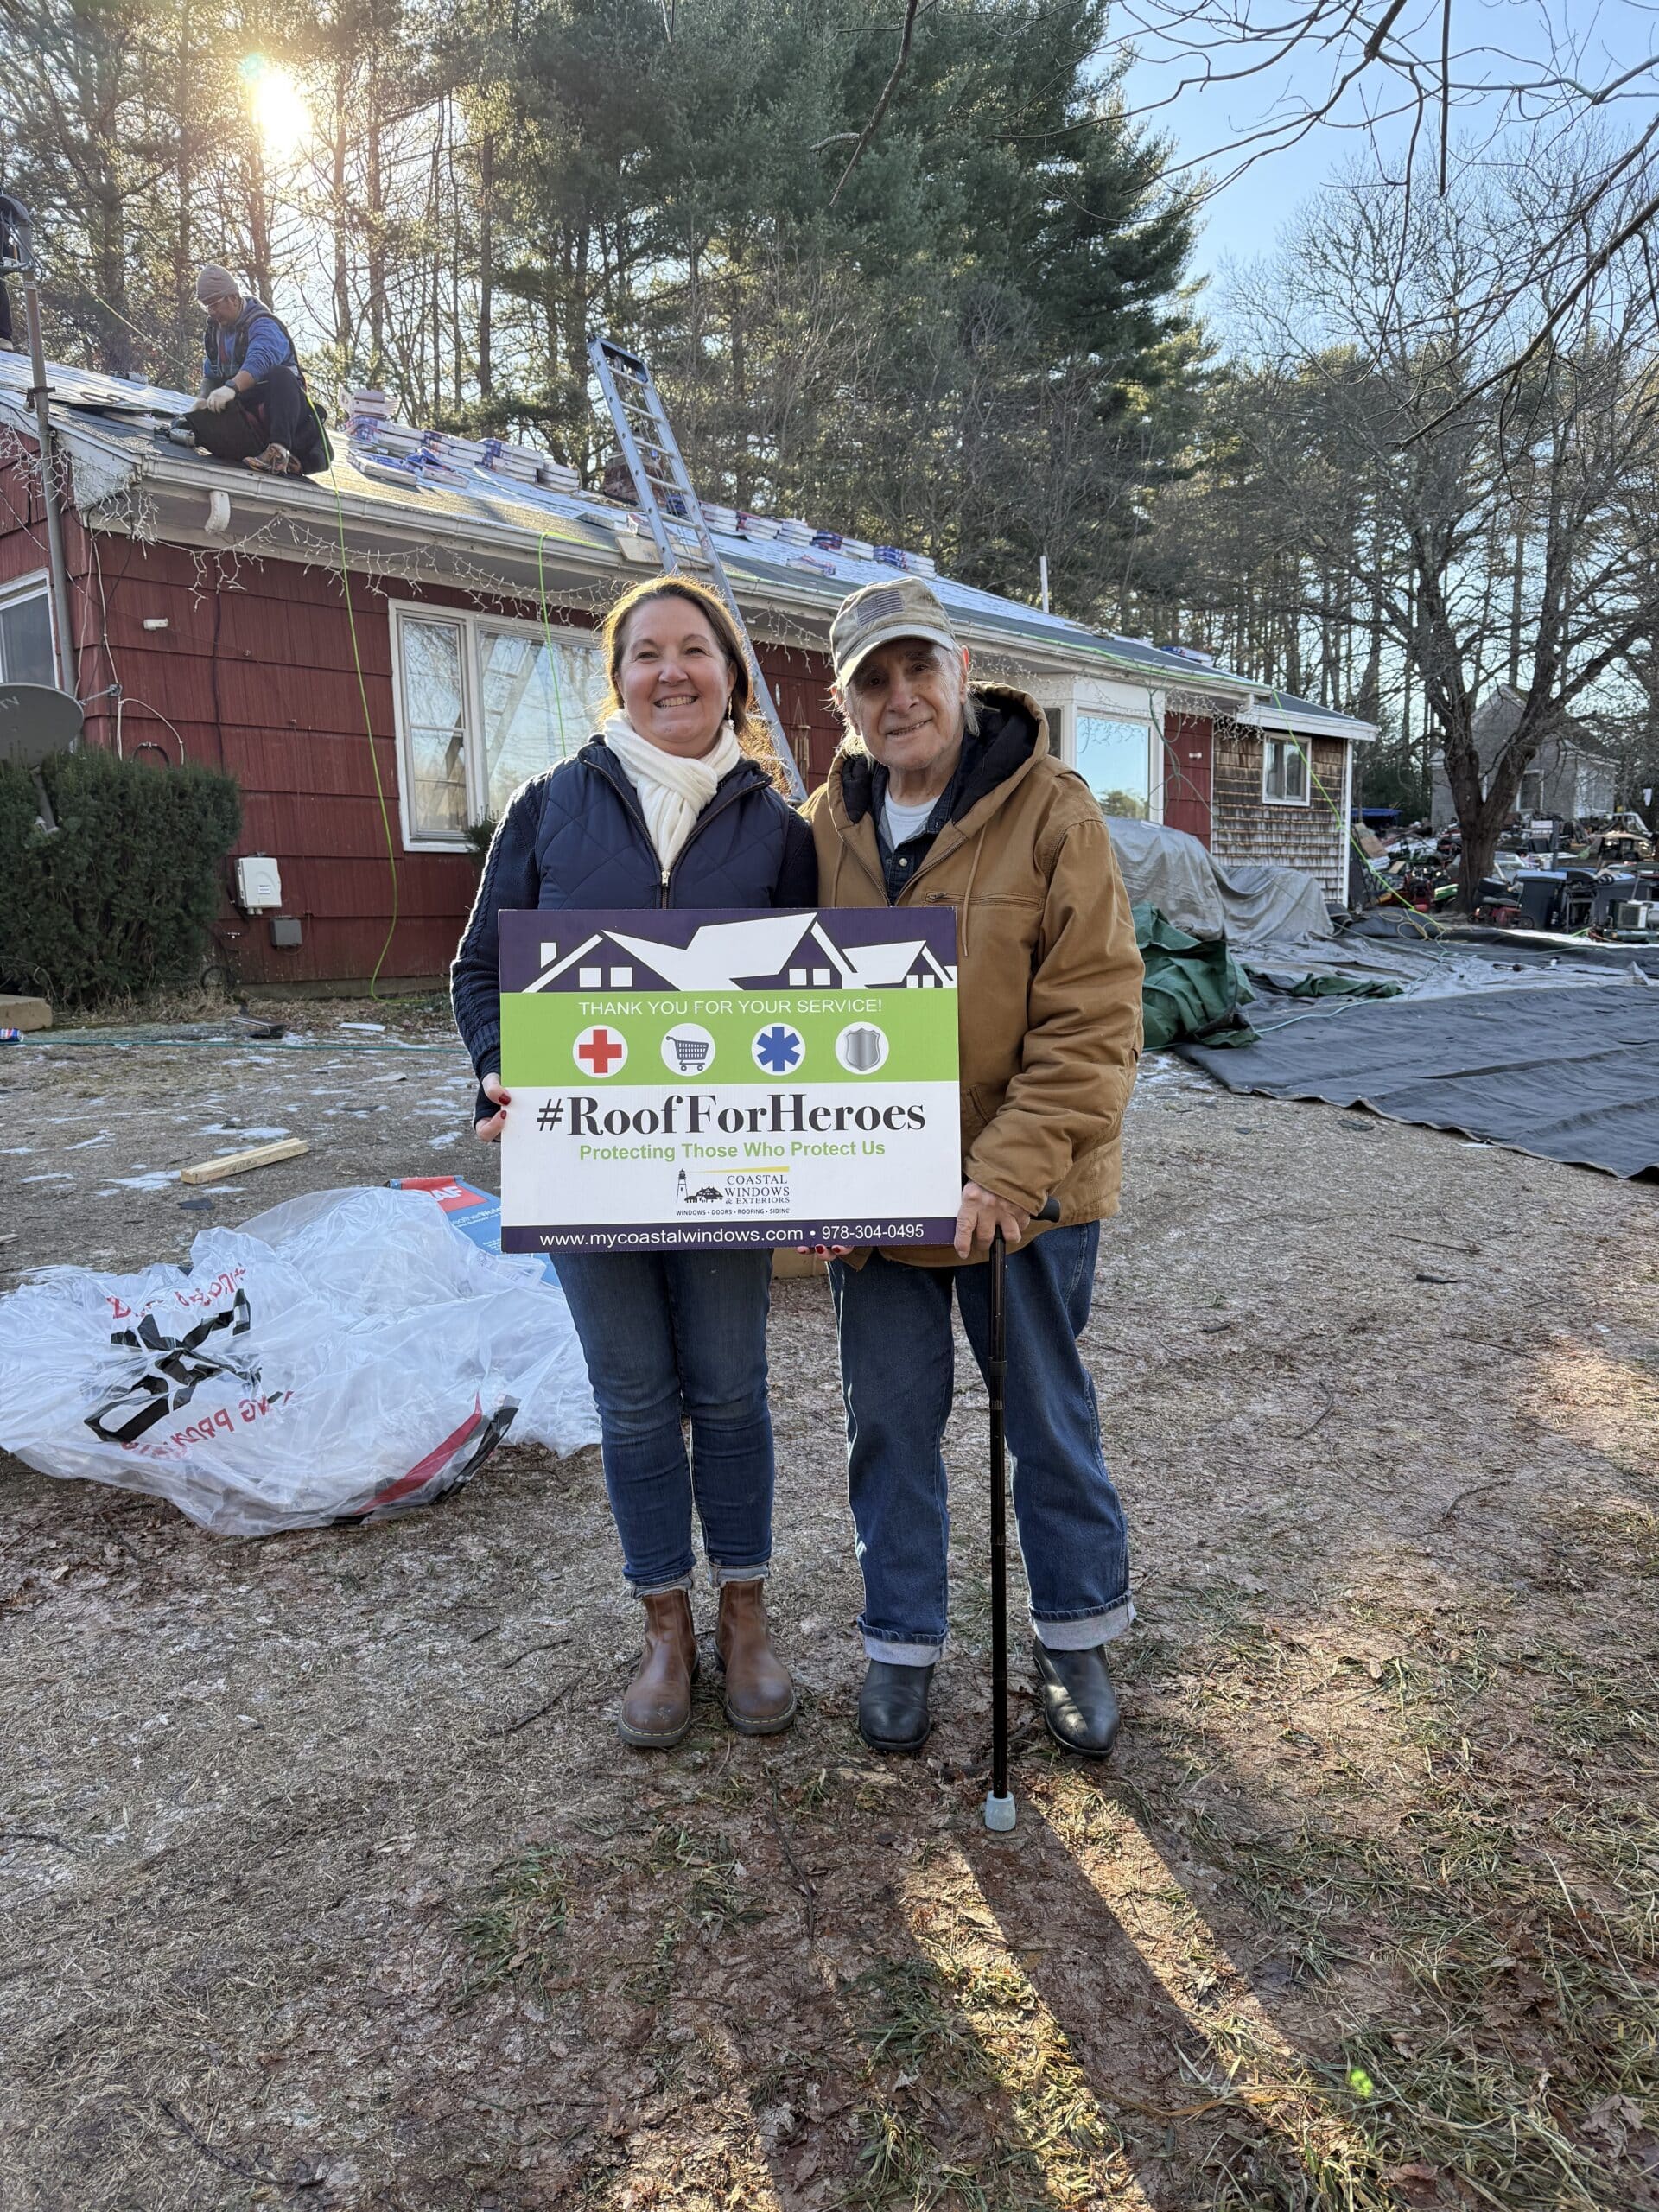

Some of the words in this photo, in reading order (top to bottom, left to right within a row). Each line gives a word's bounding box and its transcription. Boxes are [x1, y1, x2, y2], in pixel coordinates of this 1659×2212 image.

[579, 1001, 642, 1015] THANK
[648, 1001, 688, 1014] YOU
[694, 1001, 733, 1014] FOR
[738, 1000, 791, 1014] YOUR
[797, 999, 882, 1013] SERVICE!
[537, 1093, 925, 1135] #RoofForHeroes
[579, 1145, 676, 1162] Protecting
[682, 1142, 738, 1159] Those
[744, 1142, 785, 1158] Who
[791, 1141, 858, 1157] Protect
[861, 1141, 886, 1155] Us
[727, 1174, 788, 1185] COASTAL
[724, 1186, 790, 1197] WINDOWS
[539, 1228, 802, 1248] www.mycoastalwindows.com
[822, 1224, 925, 1240] 978-304-0495
